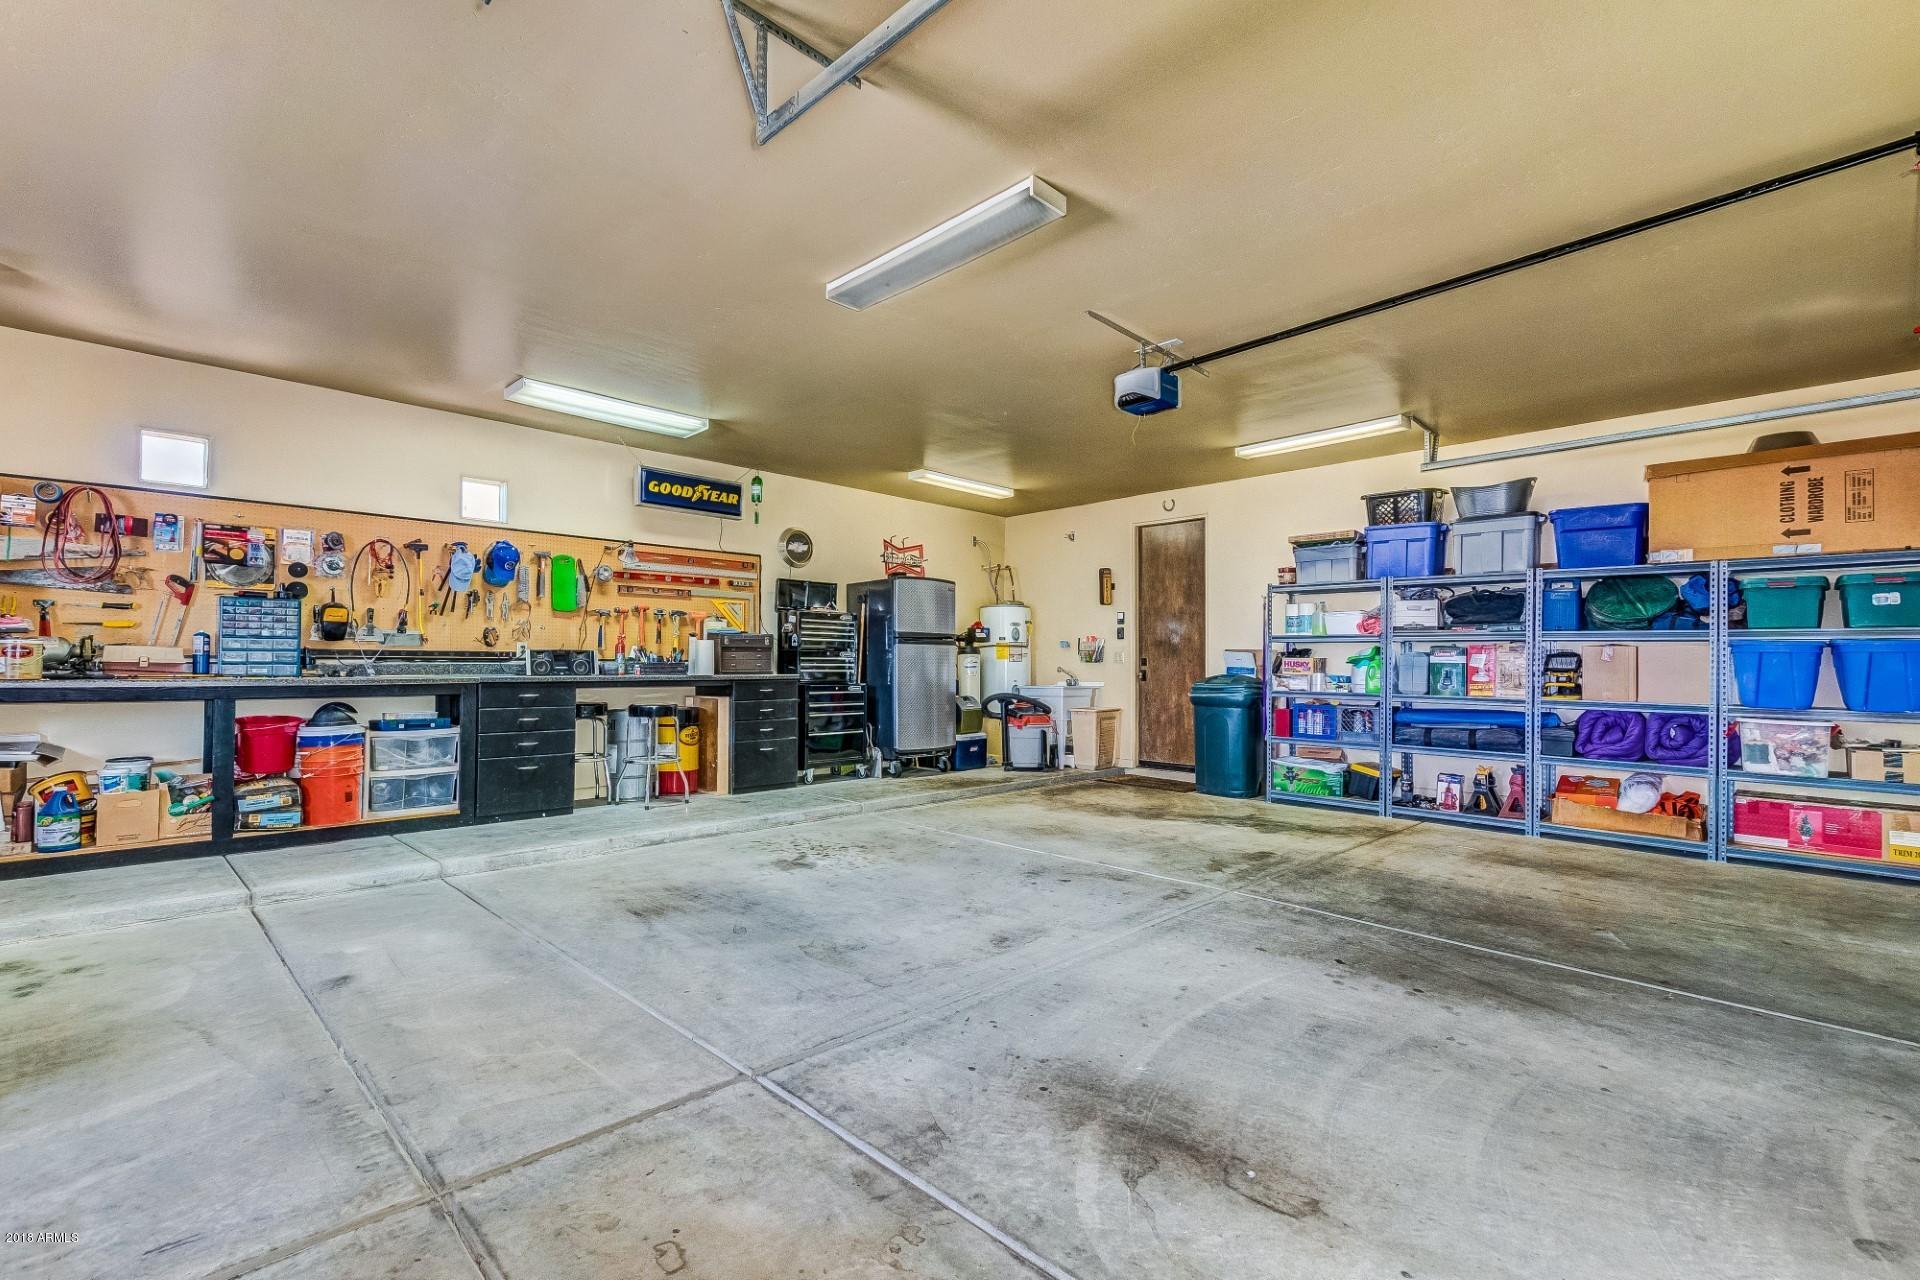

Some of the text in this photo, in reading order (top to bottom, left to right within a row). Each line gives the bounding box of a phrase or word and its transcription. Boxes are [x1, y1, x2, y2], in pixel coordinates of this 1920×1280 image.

[1780, 480, 1795, 523] CLOTHING
[1807, 476, 1824, 523] WARDROBE
[1283, 660, 1310, 668] HUSKY
[1893, 848, 1912, 858] TRIM
